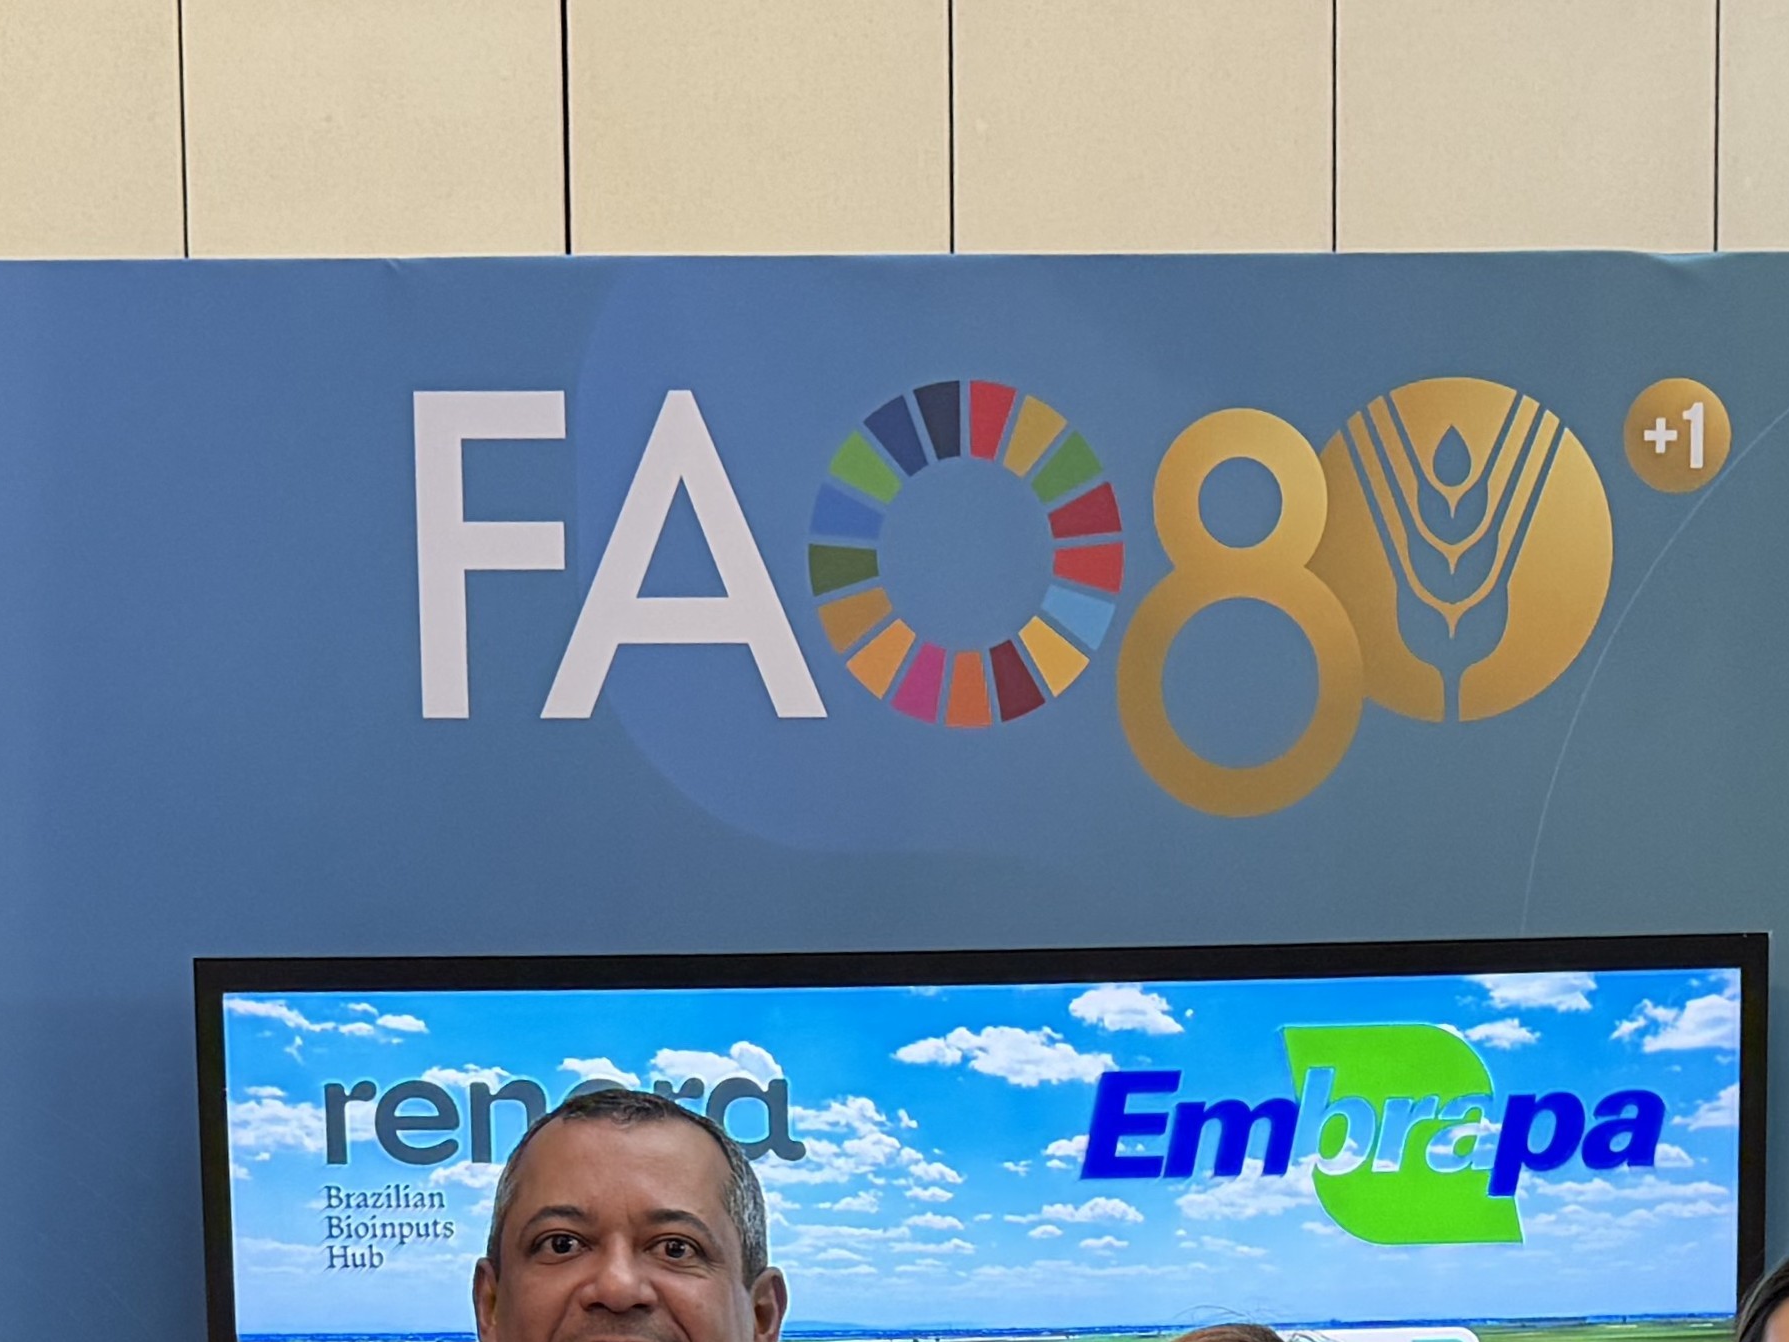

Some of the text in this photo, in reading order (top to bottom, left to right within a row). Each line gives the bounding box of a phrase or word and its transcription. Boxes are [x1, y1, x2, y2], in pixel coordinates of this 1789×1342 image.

[1643, 400, 1706, 470] +1
[323, 1077, 806, 1166] rena
[1081, 1064, 1667, 1198] Embrapa
[324, 1184, 445, 1211] Brazilian
[325, 1215, 455, 1241] Bioinputs
[328, 1246, 384, 1270] Hub
